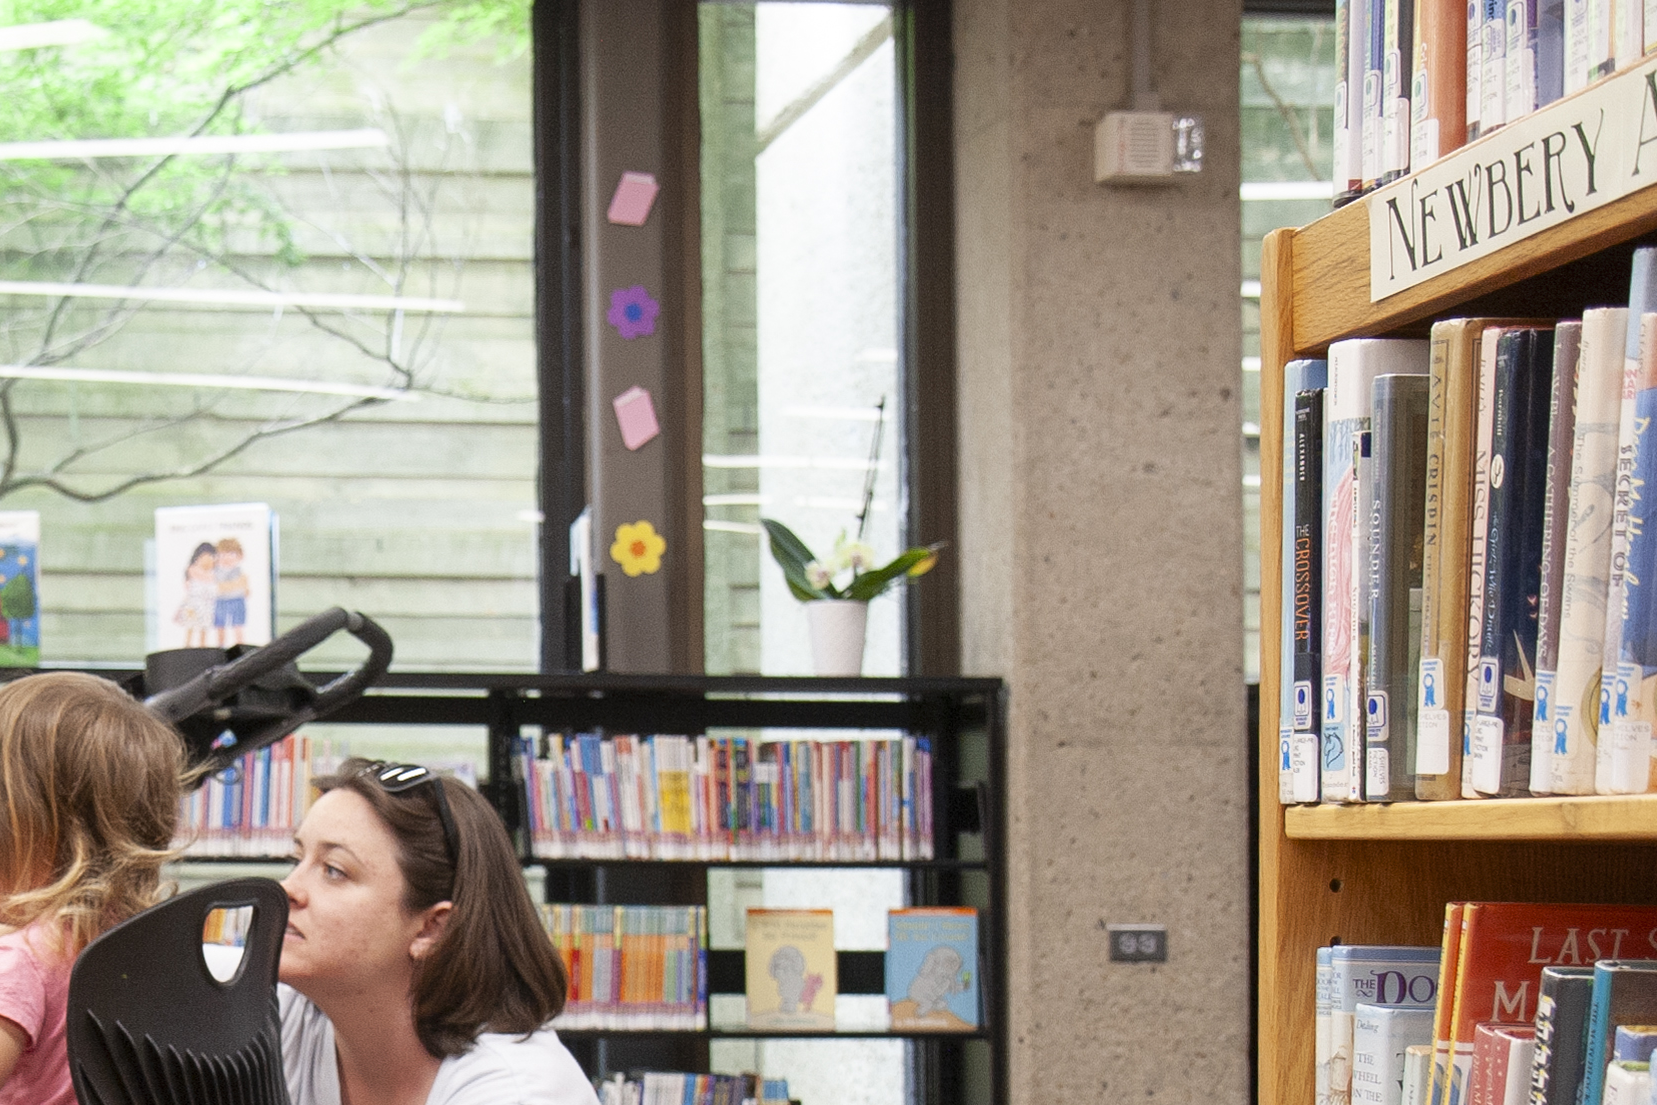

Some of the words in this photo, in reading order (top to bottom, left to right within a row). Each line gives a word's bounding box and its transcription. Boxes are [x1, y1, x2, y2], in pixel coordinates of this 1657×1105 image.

[1386, 108, 1604, 281] NEWBERY
[1298, 432, 1306, 482] ALEXANDER
[1576, 435, 1586, 460] The
[1426, 453, 1439, 546] CRISPIN
[1473, 451, 1486, 521] MISS
[1570, 465, 1584, 526] Summer
[1615, 444, 1632, 539] SECRET
[1295, 524, 1310, 537] THE
[1541, 464, 1554, 574] GATHERING
[1368, 500, 1381, 600] SOUNDER
[1566, 547, 1577, 569] the
[1612, 551, 1624, 587] OF
[1295, 538, 1311, 641] CROSSOVER
[1468, 535, 1484, 681] HICKORY
[1540, 582, 1550, 608] OF
[1563, 574, 1576, 620] Swans
[1537, 613, 1549, 658] DAYS
[1527, 926, 1629, 965] LAST
[1353, 979, 1376, 990] THE
[1370, 970, 1438, 1004] DO
[1490, 980, 1540, 1023] M
[1358, 1053, 1375, 1066] THE
[1365, 1089, 1383, 1103] THE
